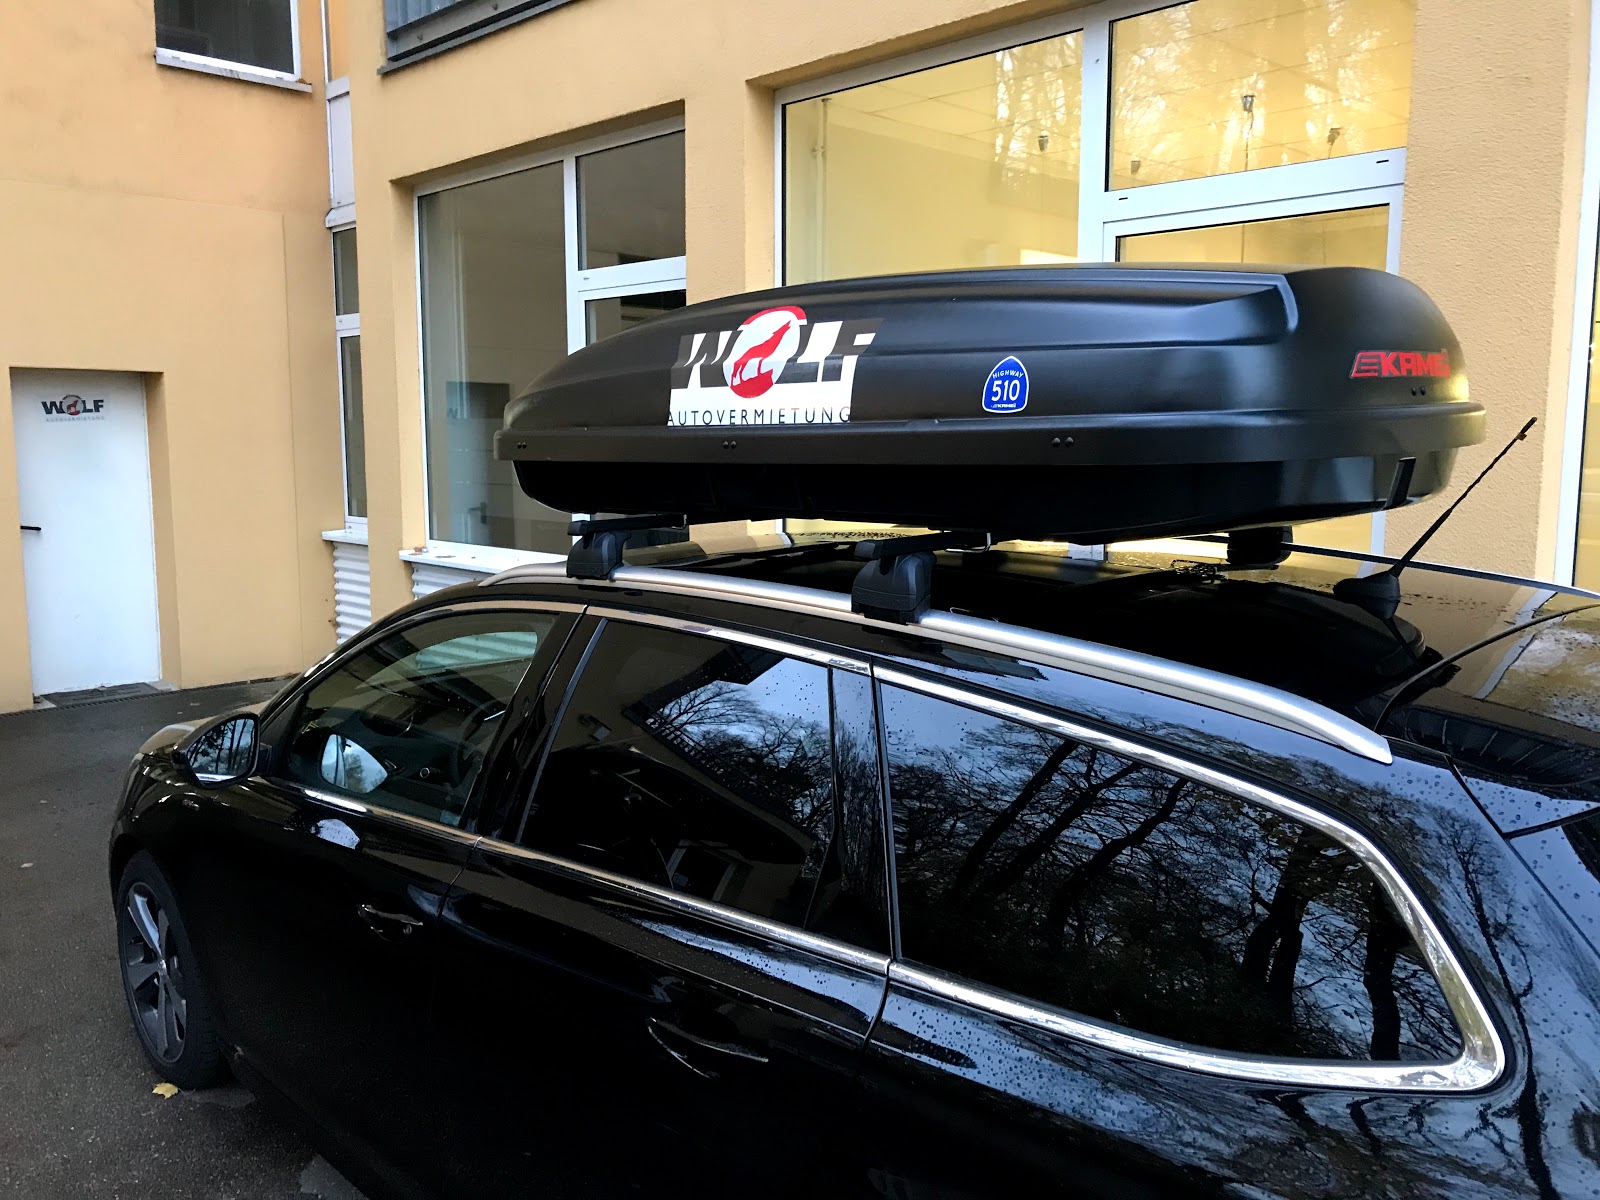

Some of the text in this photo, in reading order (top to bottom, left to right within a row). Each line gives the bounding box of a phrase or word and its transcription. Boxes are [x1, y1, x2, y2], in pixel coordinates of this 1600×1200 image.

[992, 369, 1024, 379] HIGHWAY
[991, 379, 1020, 401] 510
[41, 395, 105, 416] WOLF
[667, 405, 851, 426] AUTOVERMIETUNG
